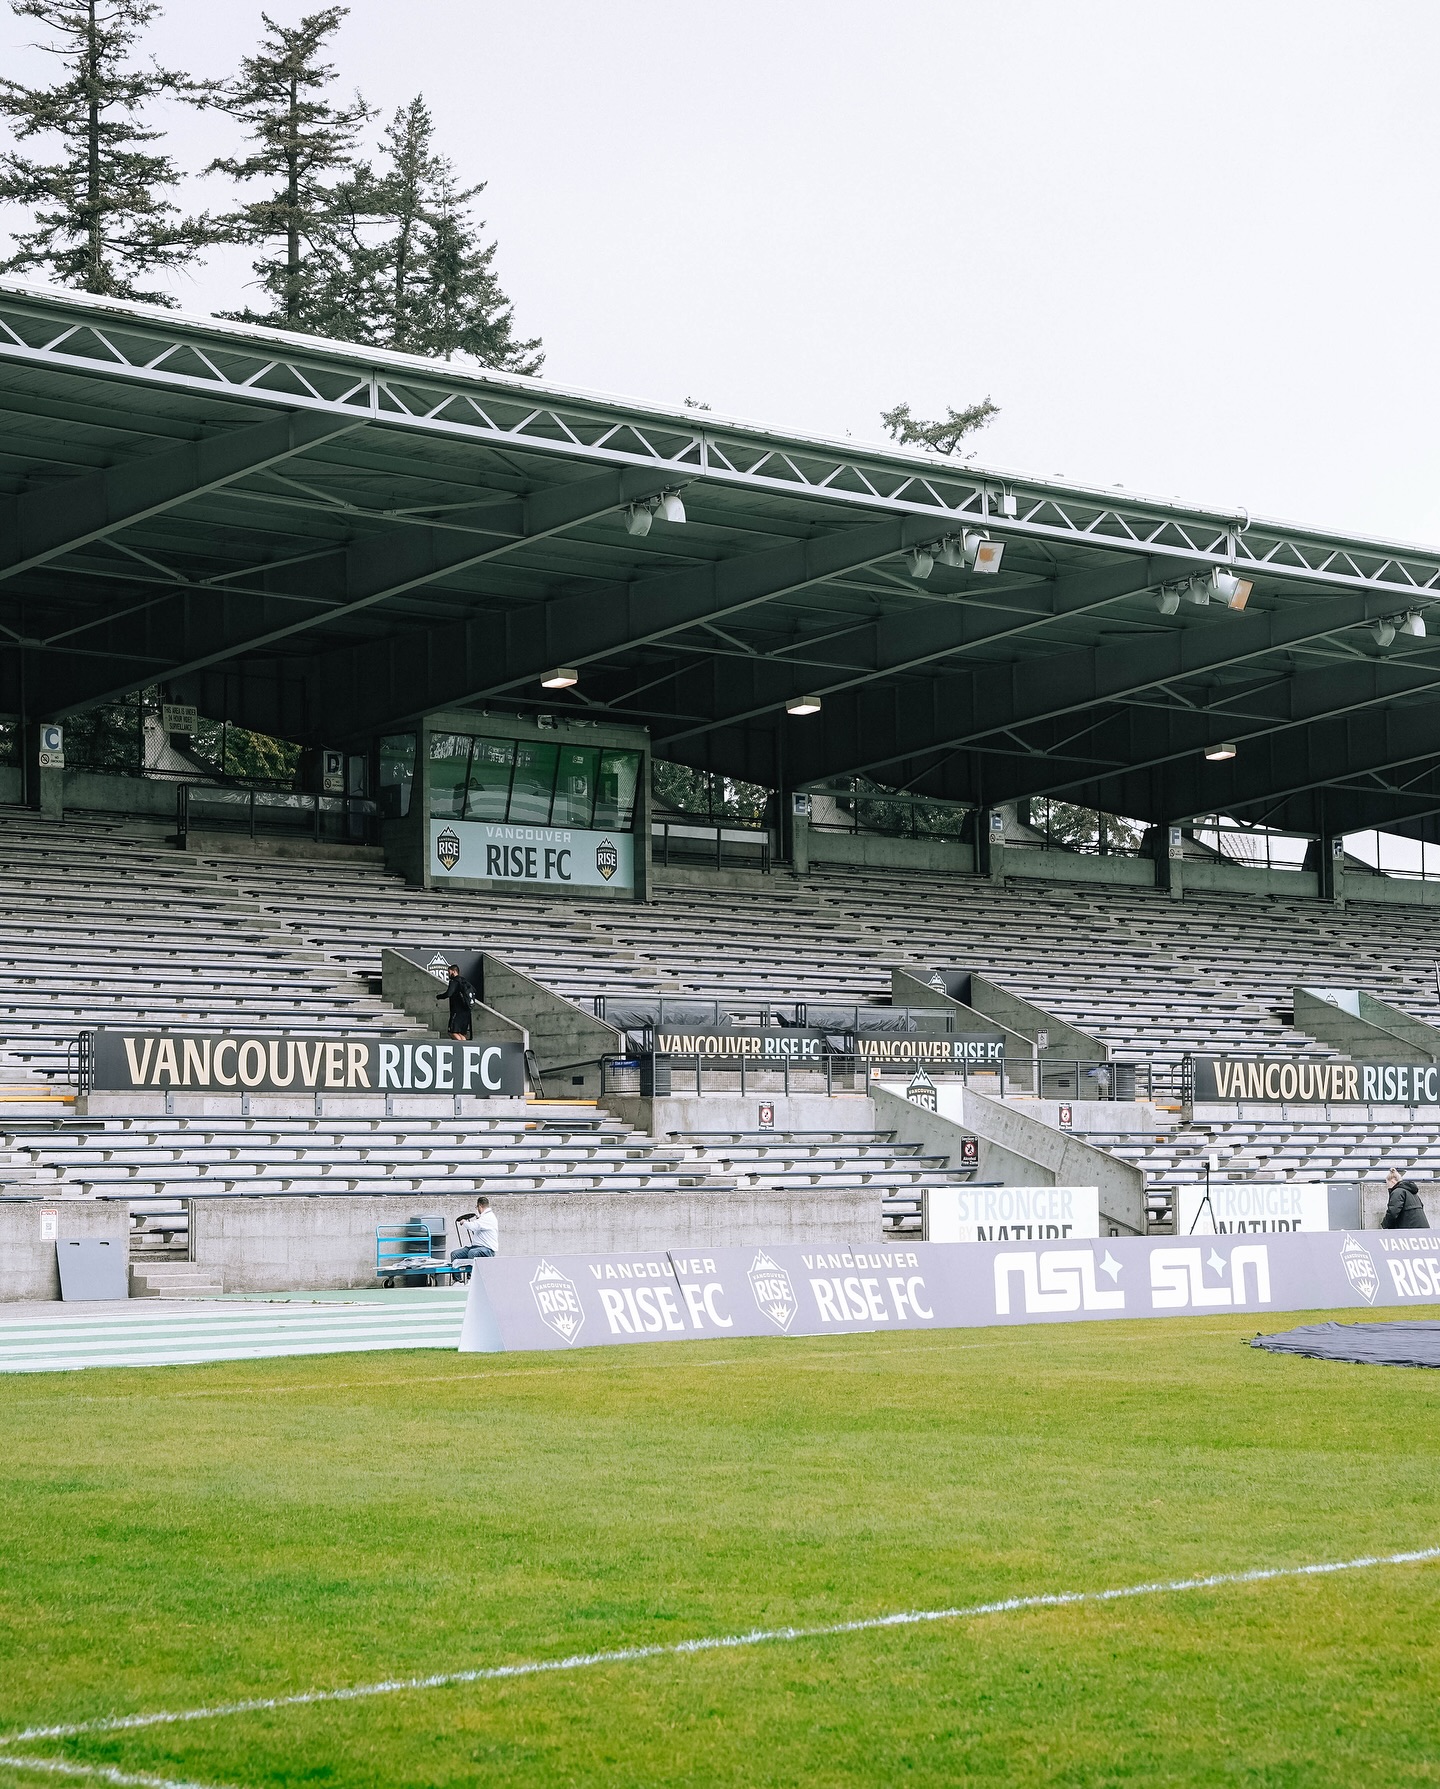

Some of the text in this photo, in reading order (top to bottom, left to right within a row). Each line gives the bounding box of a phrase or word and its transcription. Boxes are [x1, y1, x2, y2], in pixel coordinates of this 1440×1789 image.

[172, 706, 180, 715] AREA
[186, 708, 196, 716] UNDER
[45, 728, 59, 750] C
[327, 753, 340, 773] D
[486, 826, 572, 843] VANCOUVER
[1172, 830, 1180, 844] F
[438, 842, 459, 856] RISE
[598, 852, 616, 866] RISE
[486, 844, 572, 880] RISE FC
[658, 1034, 820, 1061] VANCOUVER RISE FC
[858, 1040, 1004, 1064] VANCOUVER RISE FC
[123, 1038, 502, 1090] VANCOUVER RISE FC
[1213, 1061, 1438, 1102] VANCOUVER RISE FC
[958, 1190, 1074, 1221] STRONGER
[1379, 1237, 1440, 1252] VANCOU
[588, 1258, 717, 1280] VANCOUVER
[801, 1252, 919, 1270] VANCOUVER
[1346, 1259, 1376, 1280] RISE
[535, 1282, 571, 1290] VANCOUVER
[752, 1272, 786, 1280] VANCOUVER
[538, 1290, 580, 1314] RISE
[755, 1279, 793, 1303] RISE
[808, 1276, 934, 1322] RISE FC
[598, 1282, 734, 1334] RISE FC
